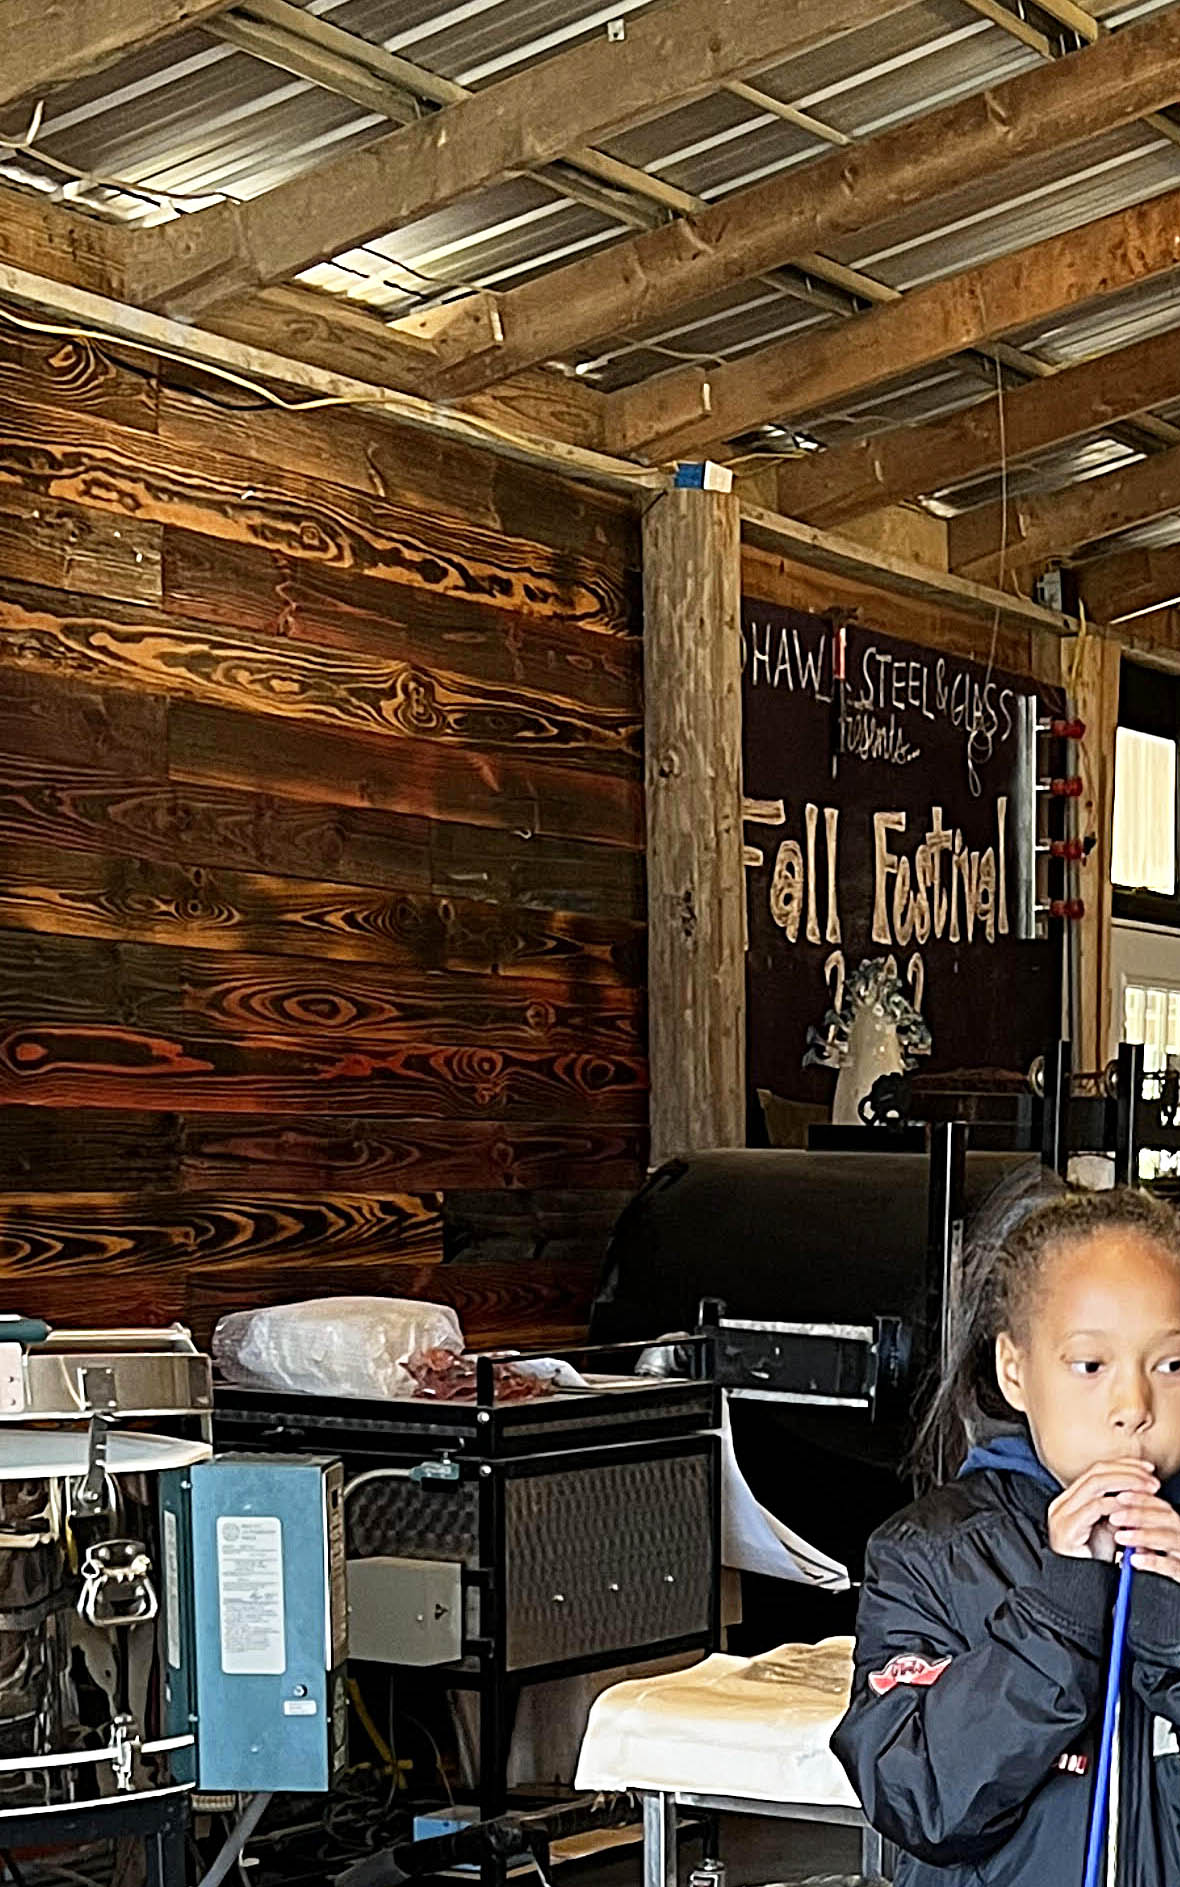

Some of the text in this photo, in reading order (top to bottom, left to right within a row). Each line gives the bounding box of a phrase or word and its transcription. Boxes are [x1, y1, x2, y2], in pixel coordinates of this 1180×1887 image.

[862, 647, 935, 720] STEEL
[936, 657, 949, 715] &
[871, 796, 1009, 947] Festival
